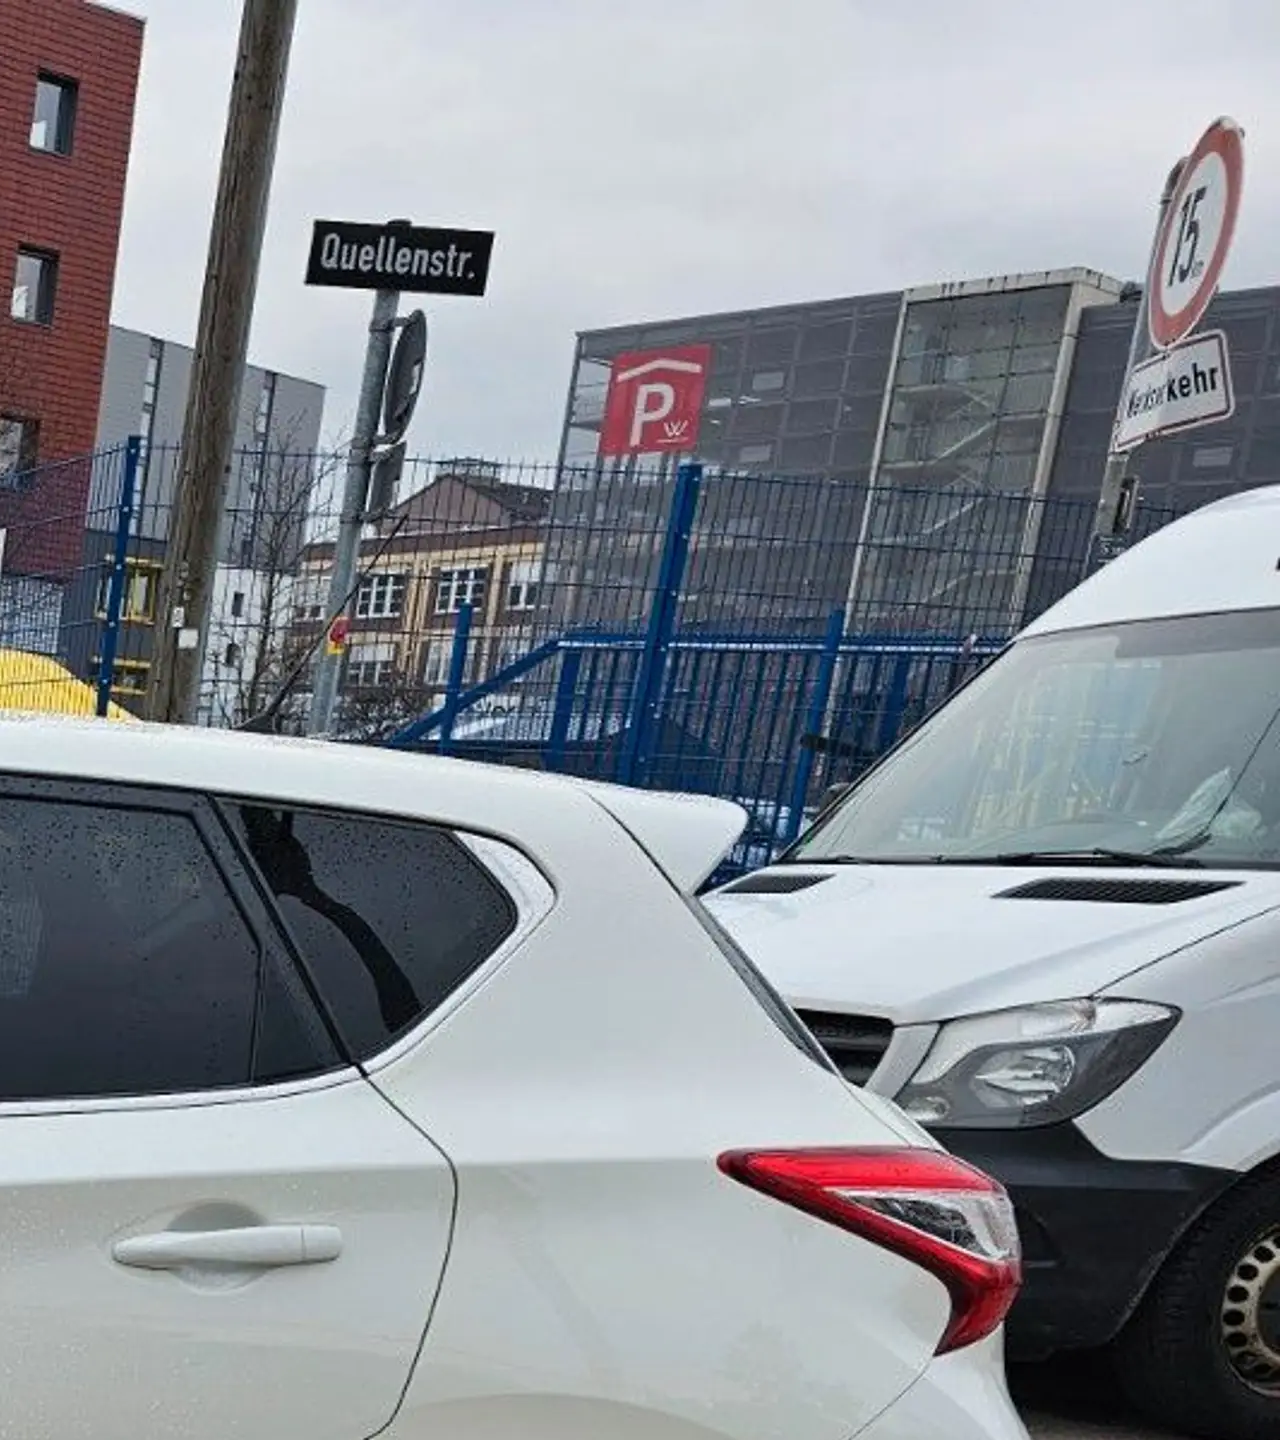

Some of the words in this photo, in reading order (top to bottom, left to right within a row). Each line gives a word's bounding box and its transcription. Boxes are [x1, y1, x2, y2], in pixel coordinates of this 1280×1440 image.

[321, 233, 476, 280] Quellenstr.
[1168, 186, 1207, 287] 15
[629, 383, 675, 447] P
